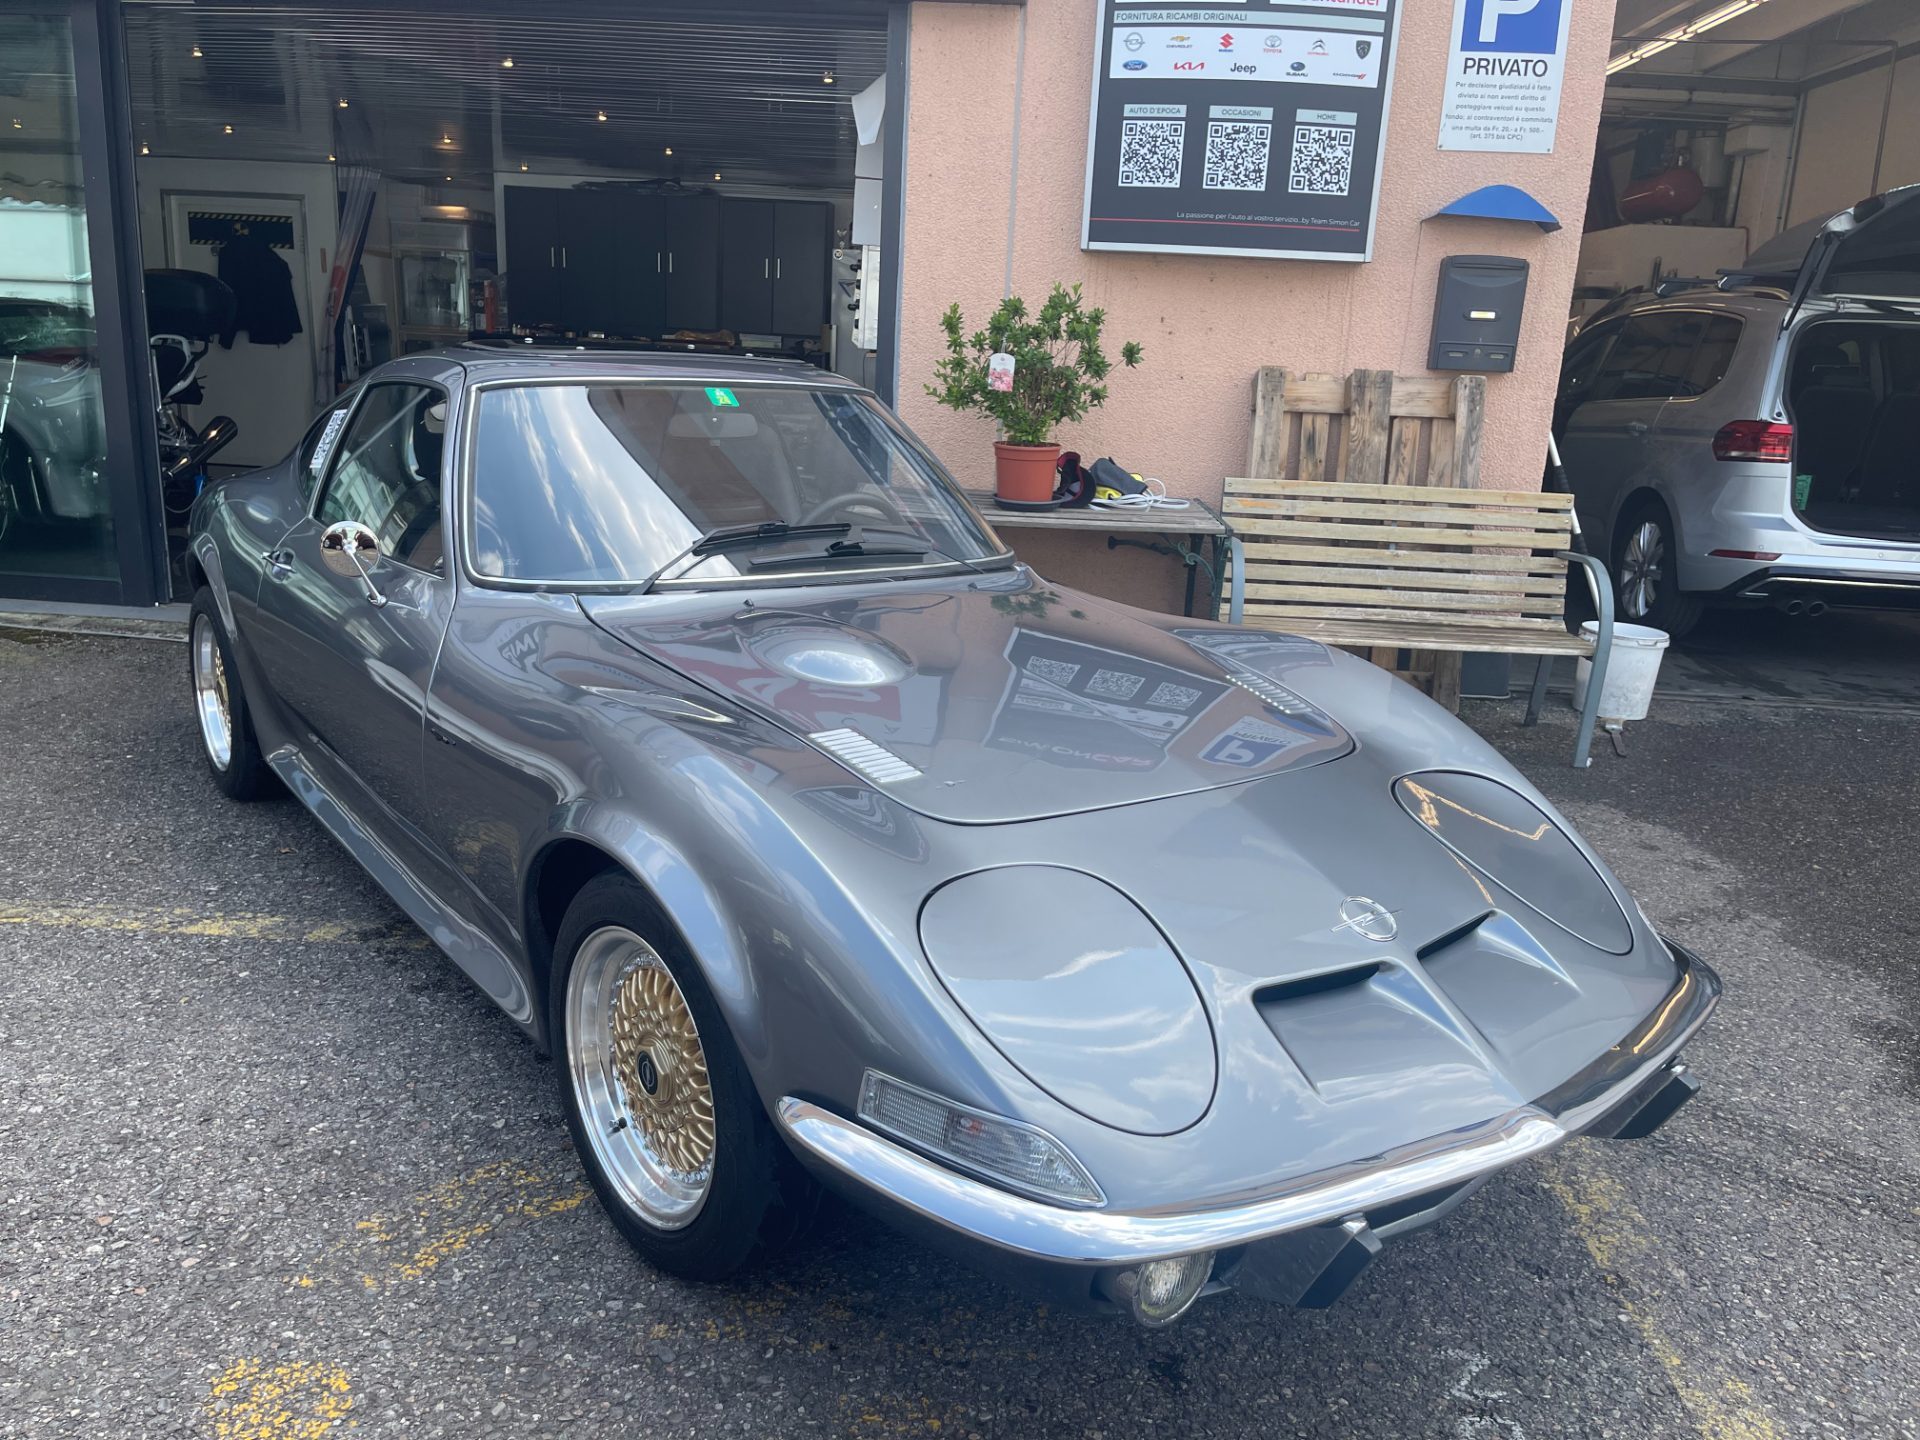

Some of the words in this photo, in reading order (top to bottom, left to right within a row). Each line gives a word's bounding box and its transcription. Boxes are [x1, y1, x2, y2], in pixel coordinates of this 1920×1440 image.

[1116, 12, 1164, 21] FORNITURA
[1166, 12, 1201, 21] RICAMBI
[1203, 12, 1248, 21] ORIGINALI
[1230, 62, 1257, 75] Jeep
[1463, 57, 1548, 77] PRIVATO
[1128, 106, 1149, 114] AUTO
[1149, 106, 1181, 115] D'EPOCA
[1221, 108, 1261, 117] OCCASIONI
[1316, 113, 1337, 121] HOME
[1185, 211, 1215, 219] passione
[1349, 219, 1360, 227] Car
